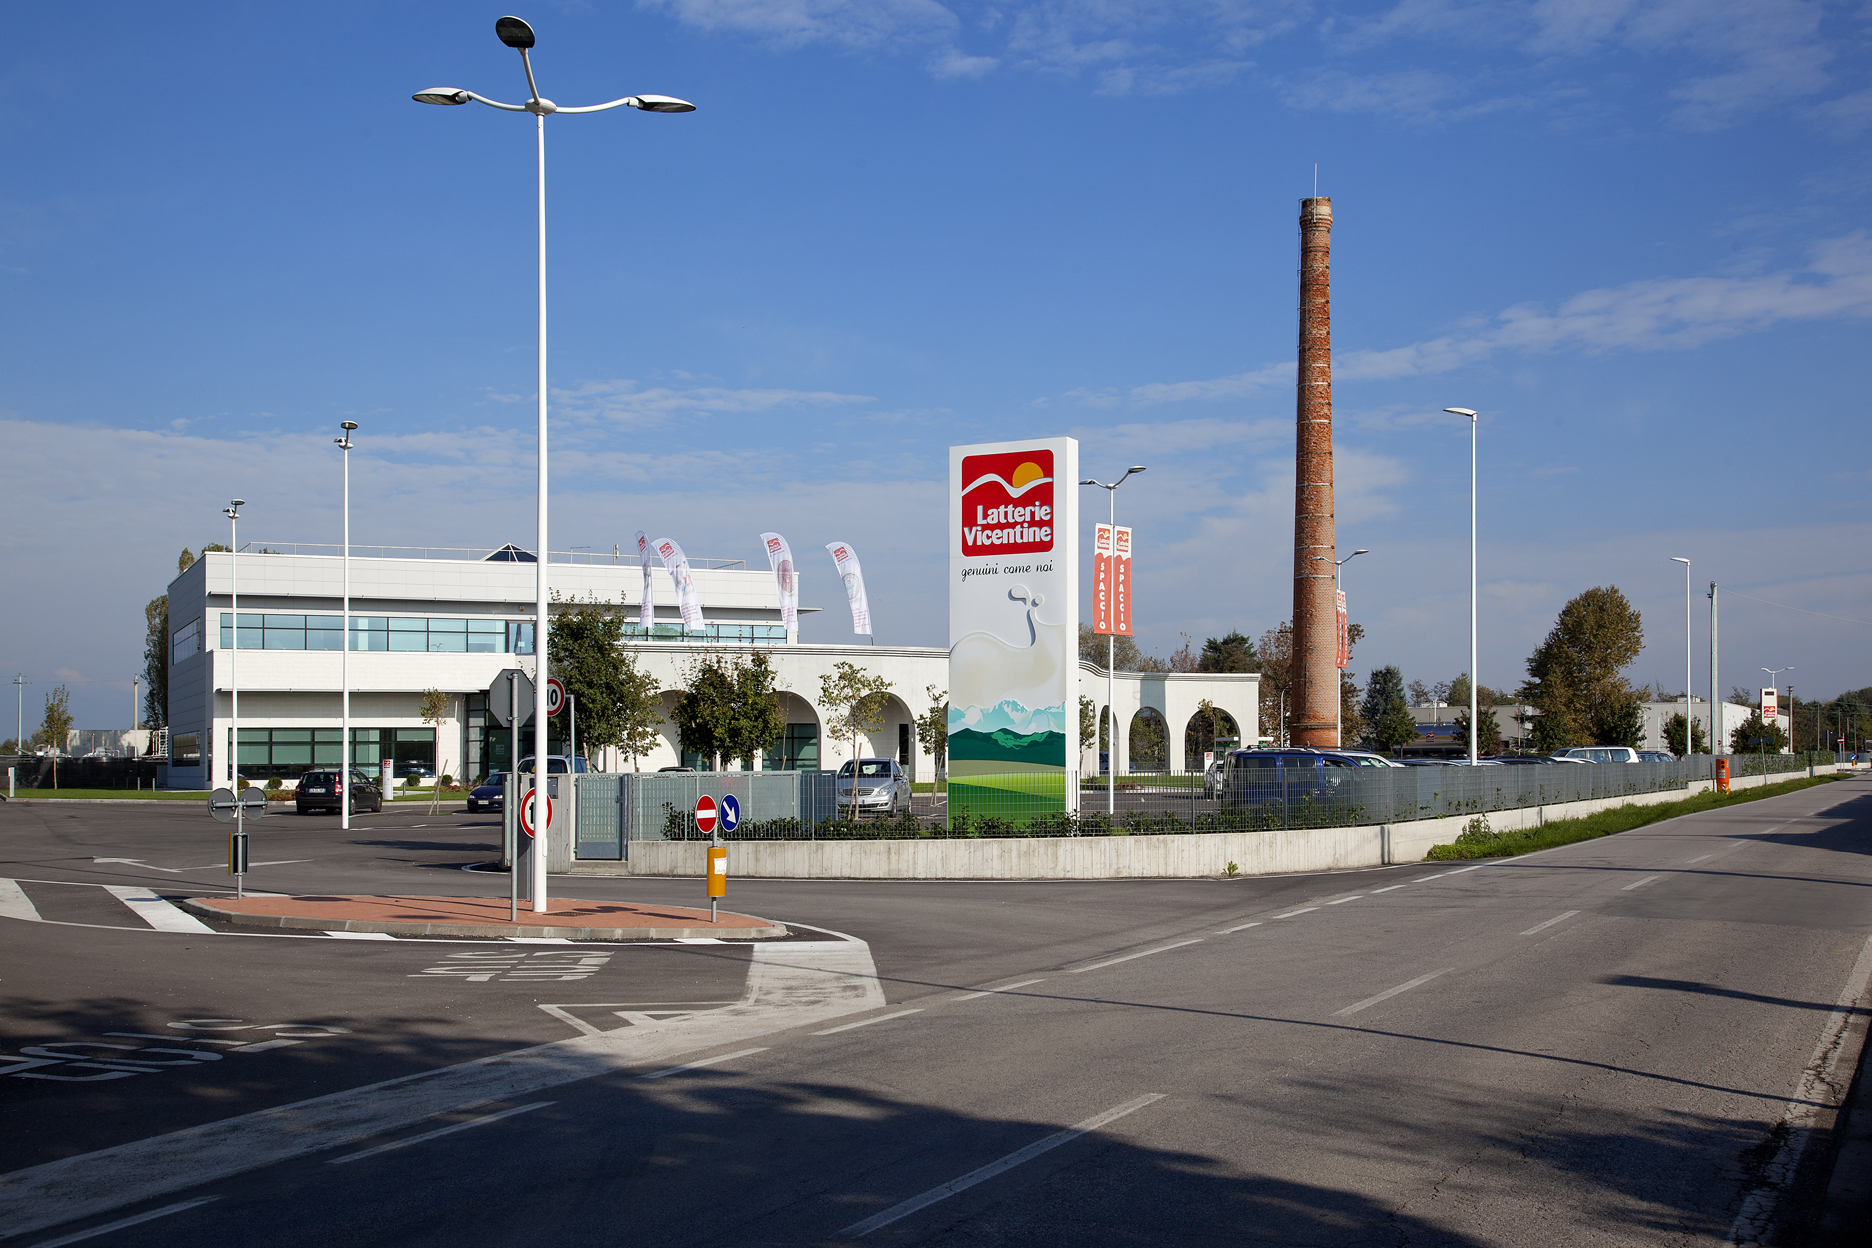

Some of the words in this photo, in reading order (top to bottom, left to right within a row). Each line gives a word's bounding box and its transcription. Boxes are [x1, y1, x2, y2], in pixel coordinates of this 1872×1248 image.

[976, 501, 1052, 525] Latterie
[963, 523, 1052, 546] Vicentine
[961, 562, 999, 583] genuini
[1003, 564, 1031, 575] come
[1035, 559, 1054, 573] noi
[1098, 562, 1106, 630] SPACCIO
[1118, 564, 1127, 631] SPACCIO
